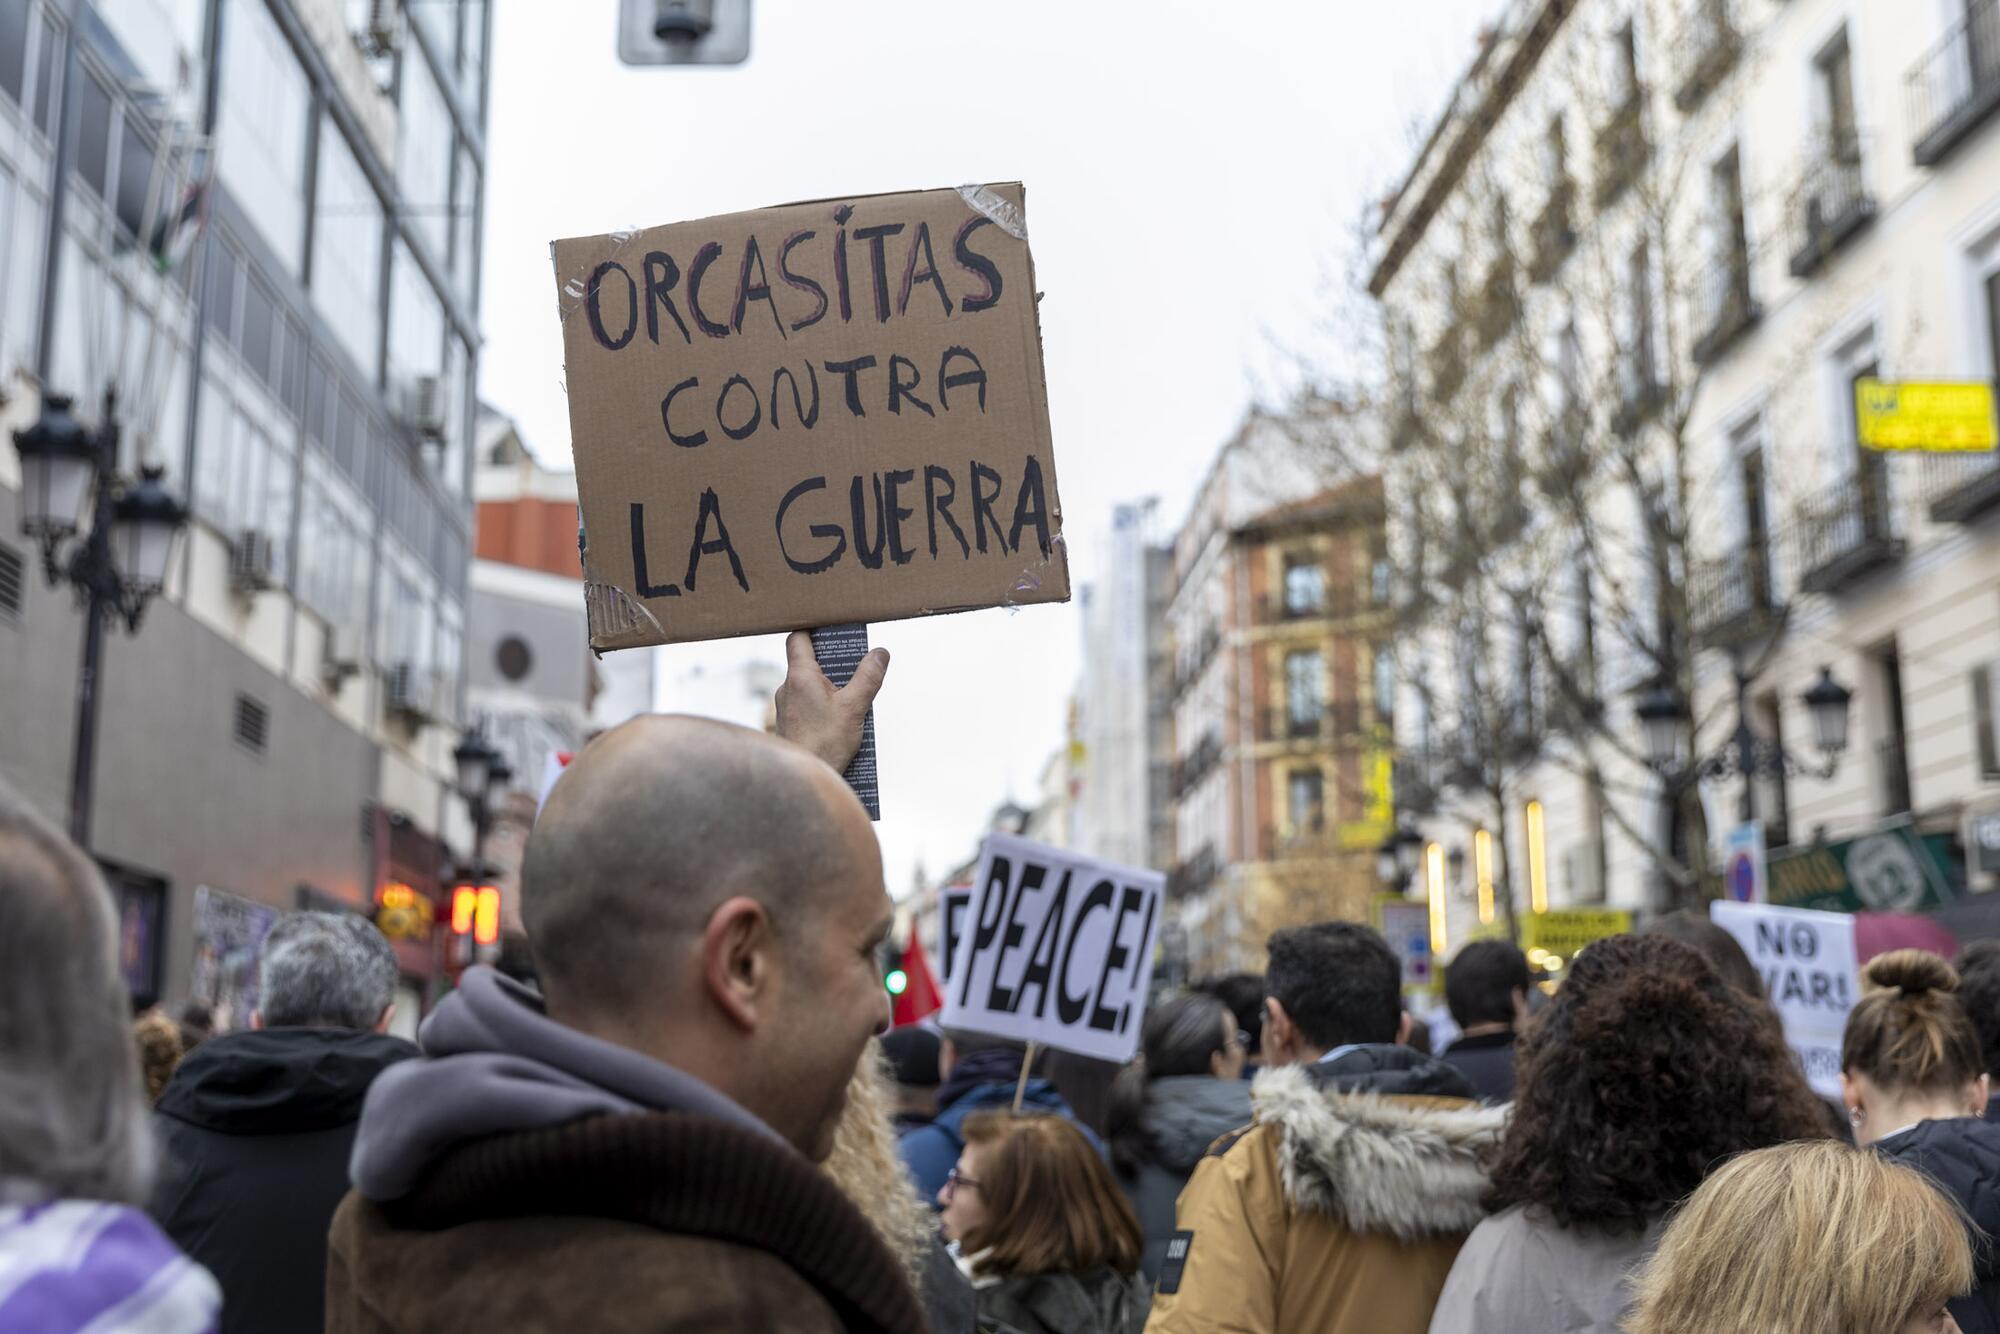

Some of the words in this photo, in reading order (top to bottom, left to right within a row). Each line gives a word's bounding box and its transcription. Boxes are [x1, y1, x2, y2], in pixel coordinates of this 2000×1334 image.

[661, 345, 987, 448] CONTRA
[631, 486, 750, 599] LA
[775, 454, 1053, 576] GUERRA
[959, 855, 1158, 1035] PEACE!
[1755, 920, 1818, 961] NO
